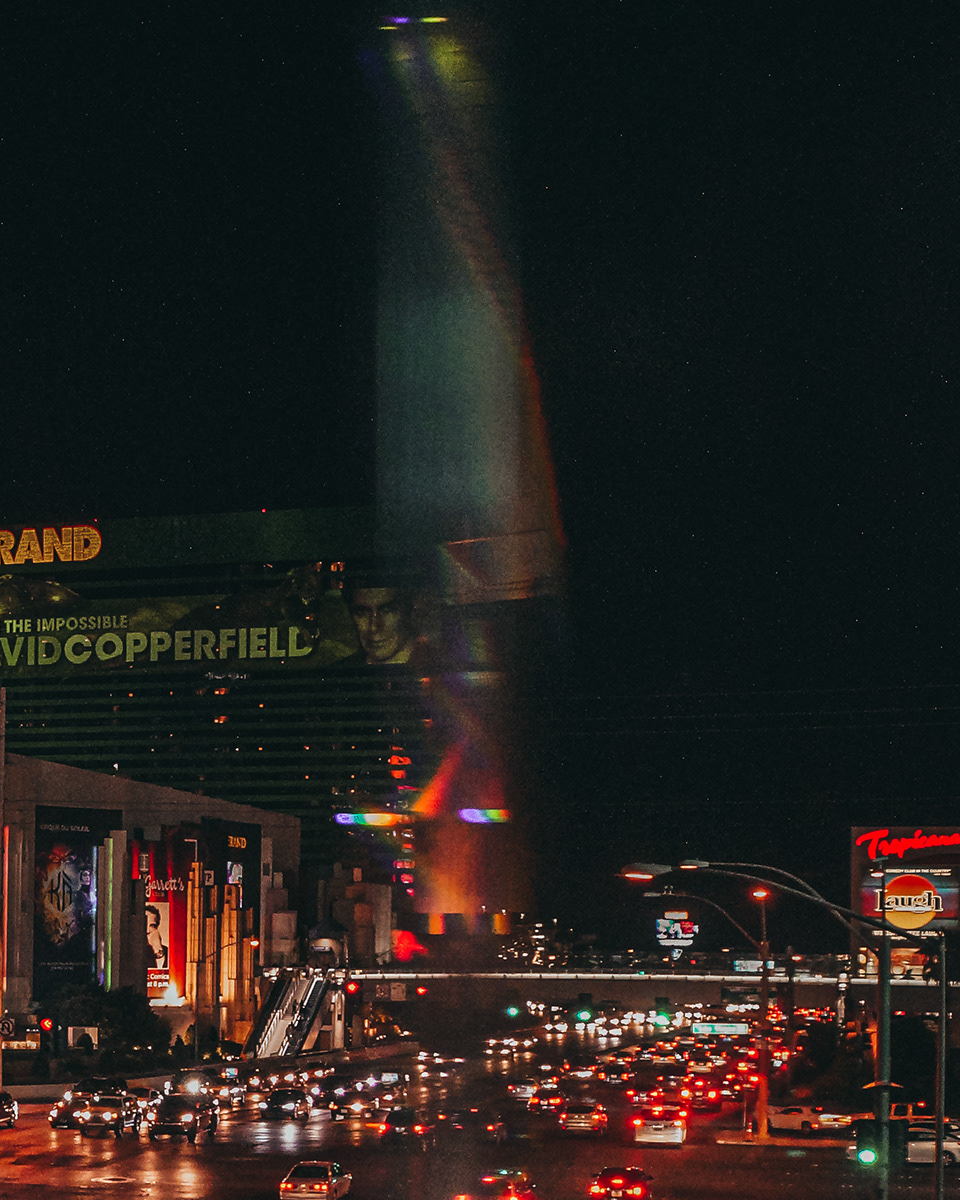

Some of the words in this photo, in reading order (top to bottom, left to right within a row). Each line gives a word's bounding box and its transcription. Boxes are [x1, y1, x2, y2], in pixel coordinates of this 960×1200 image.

[4, 618, 32, 634] THE
[36, 615, 129, 632] IMPOSSIBLE
[144, 874, 185, 898] Garrett's
[874, 889, 944, 914] Laugh
